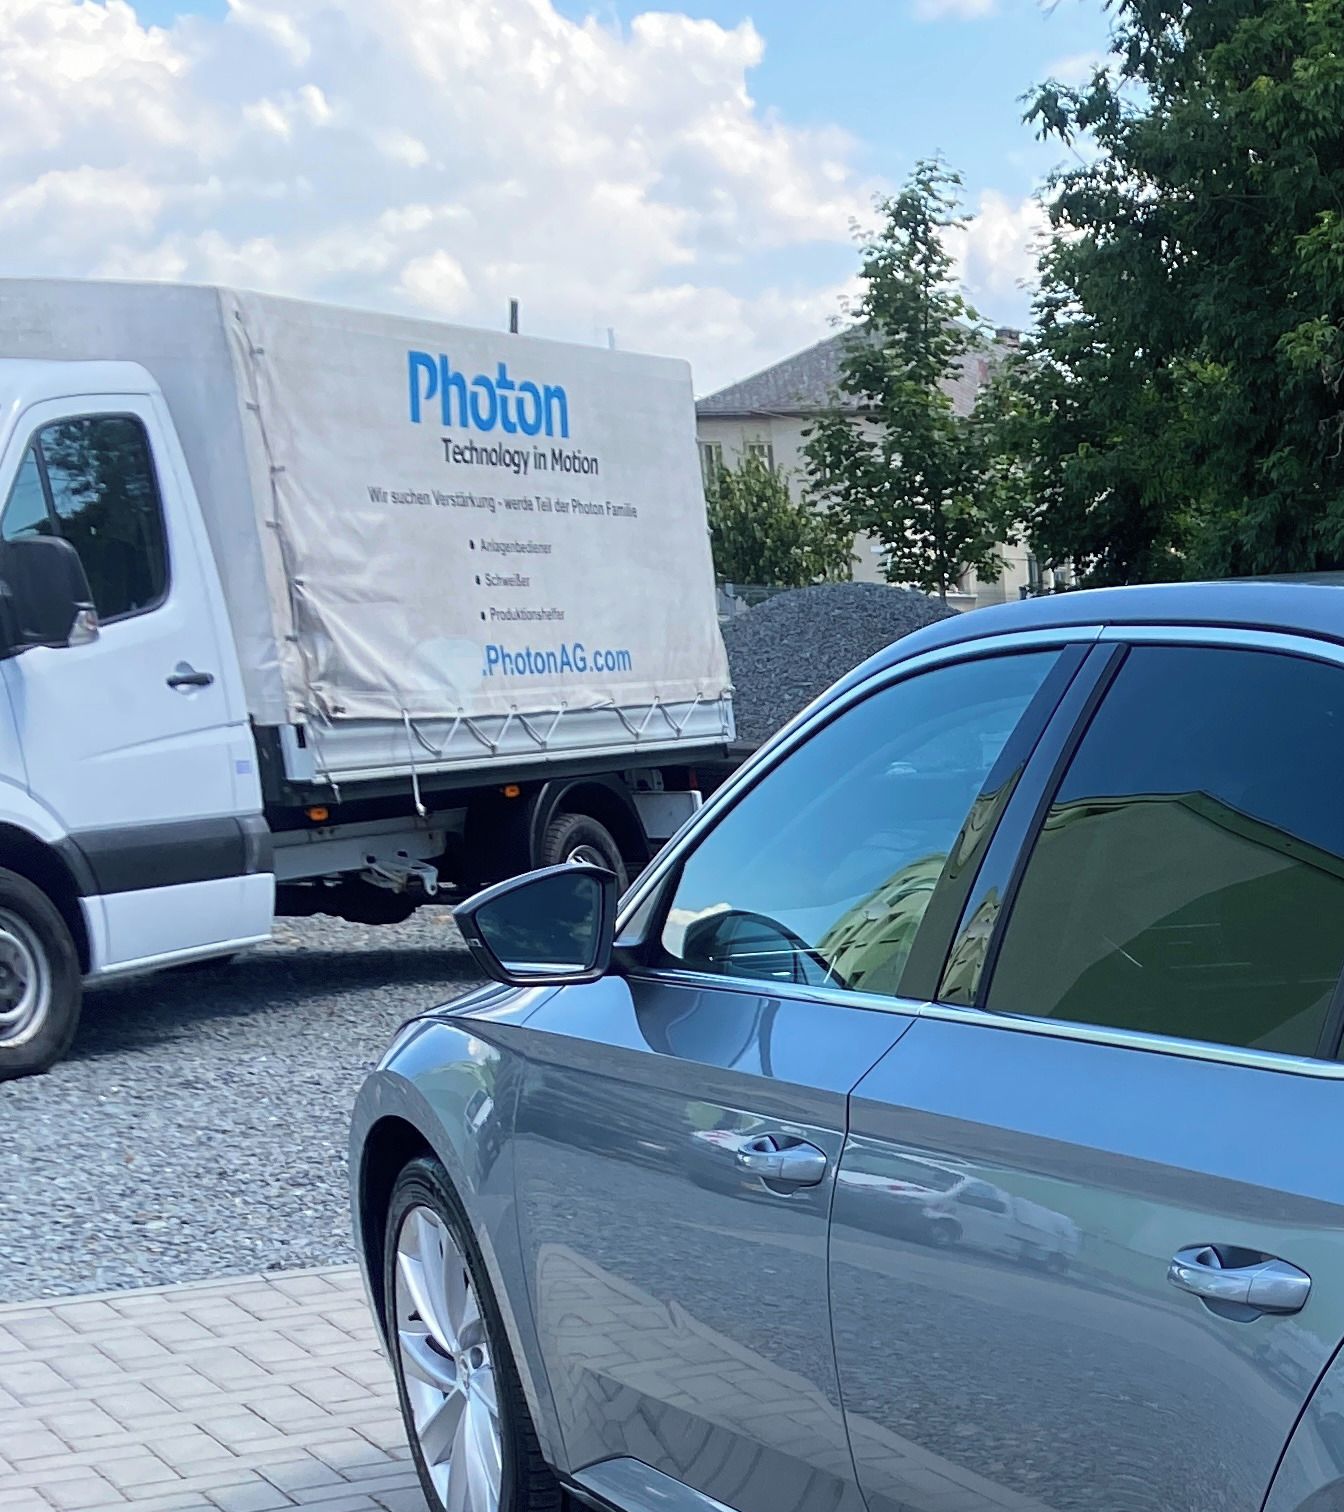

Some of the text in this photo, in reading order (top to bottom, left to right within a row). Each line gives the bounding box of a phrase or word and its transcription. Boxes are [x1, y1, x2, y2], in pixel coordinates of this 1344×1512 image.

[408, 350, 569, 438] Photon
[441, 437, 599, 475] Technology in Motion
[367, 486, 388, 503] Wir
[391, 488, 430, 505] suchen
[431, 488, 496, 513] Verstärkung
[503, 495, 534, 511] werde
[535, 496, 553, 512] Teil
[554, 498, 570, 513] der
[571, 498, 605, 516] Photon
[605, 500, 638, 518] Familie
